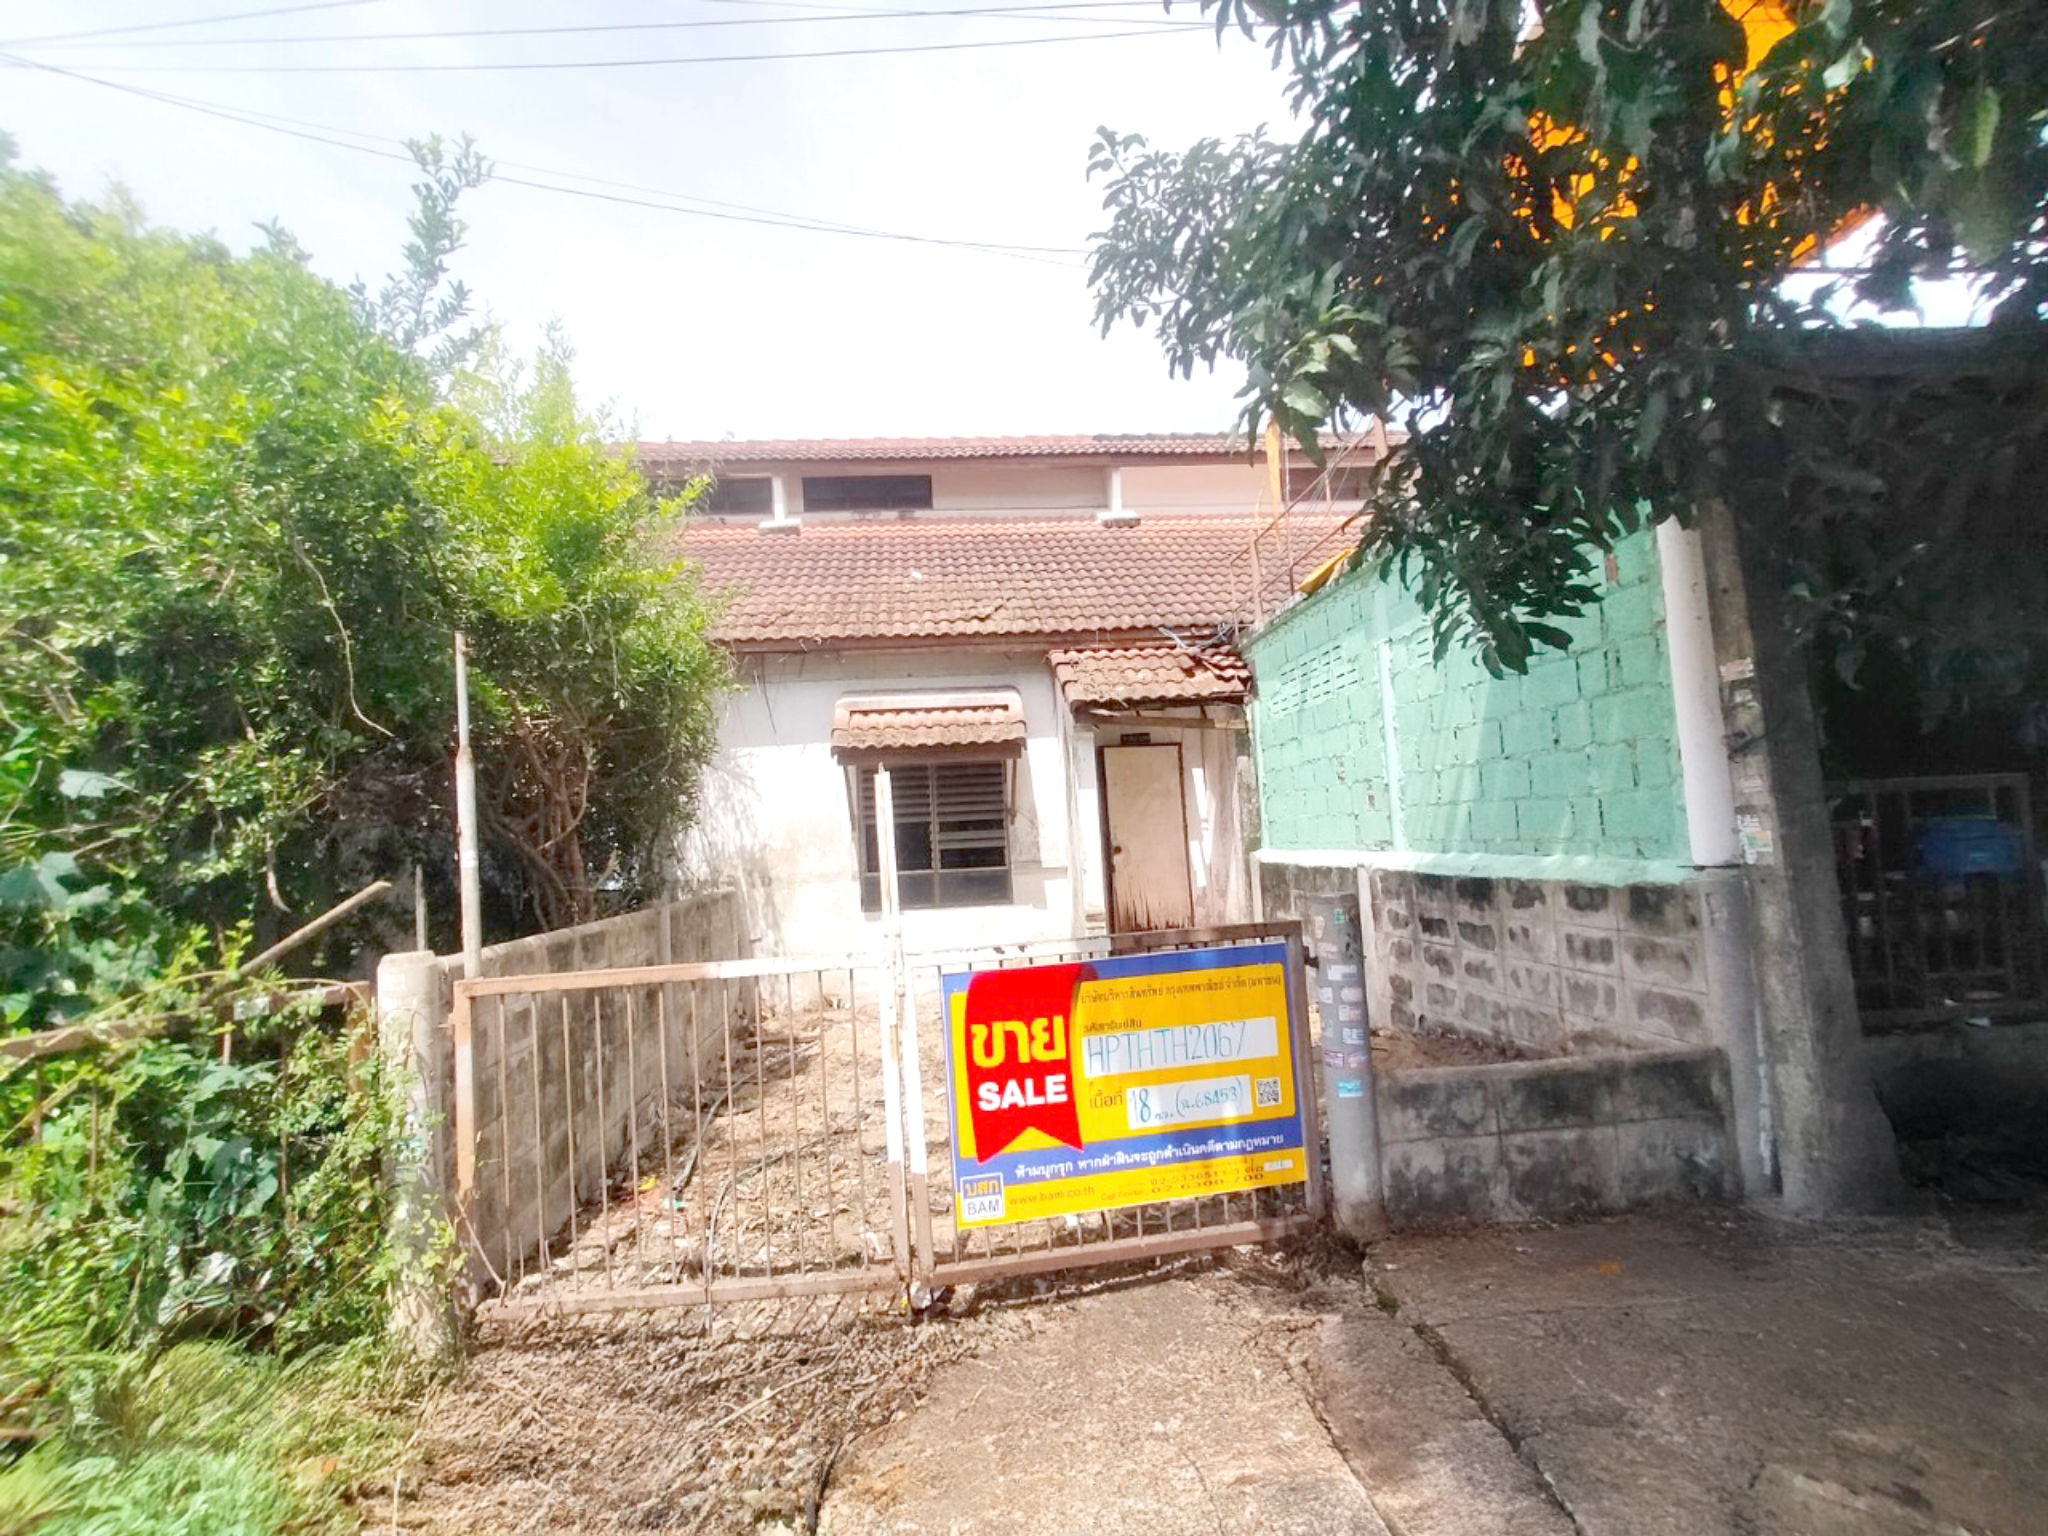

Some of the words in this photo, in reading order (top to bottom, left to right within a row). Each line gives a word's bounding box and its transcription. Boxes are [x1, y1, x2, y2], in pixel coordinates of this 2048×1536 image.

[970, 1015, 1067, 1068] ขาย
[1087, 1020, 1247, 1073] HPTHTH2067
[977, 1074, 1068, 1111] SALE
[967, 1199, 1000, 1216] BAM
[1009, 1184, 1096, 1207] www.bam.co.th
